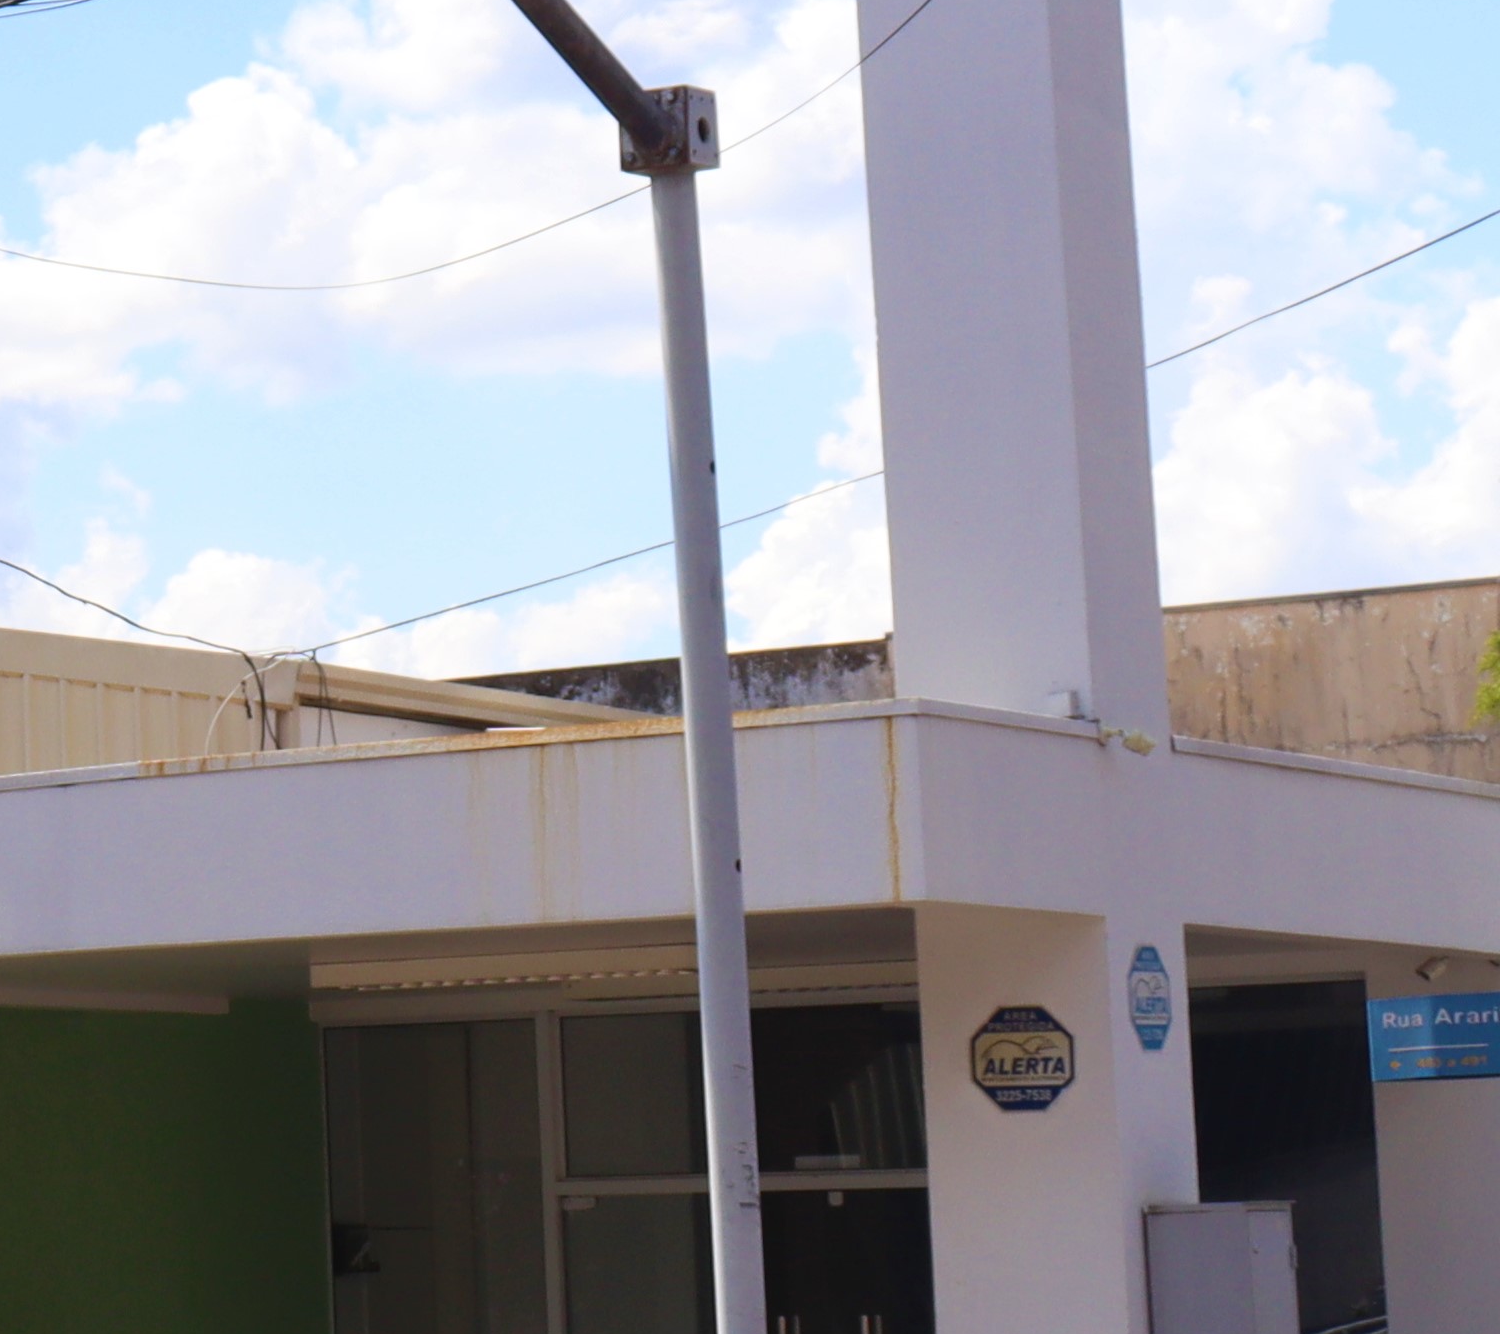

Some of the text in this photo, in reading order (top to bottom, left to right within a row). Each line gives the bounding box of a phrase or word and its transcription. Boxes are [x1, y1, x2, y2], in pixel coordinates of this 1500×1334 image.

[1382, 1006, 1500, 1028] Rua Arari
[984, 1057, 1065, 1075] ALERTA
